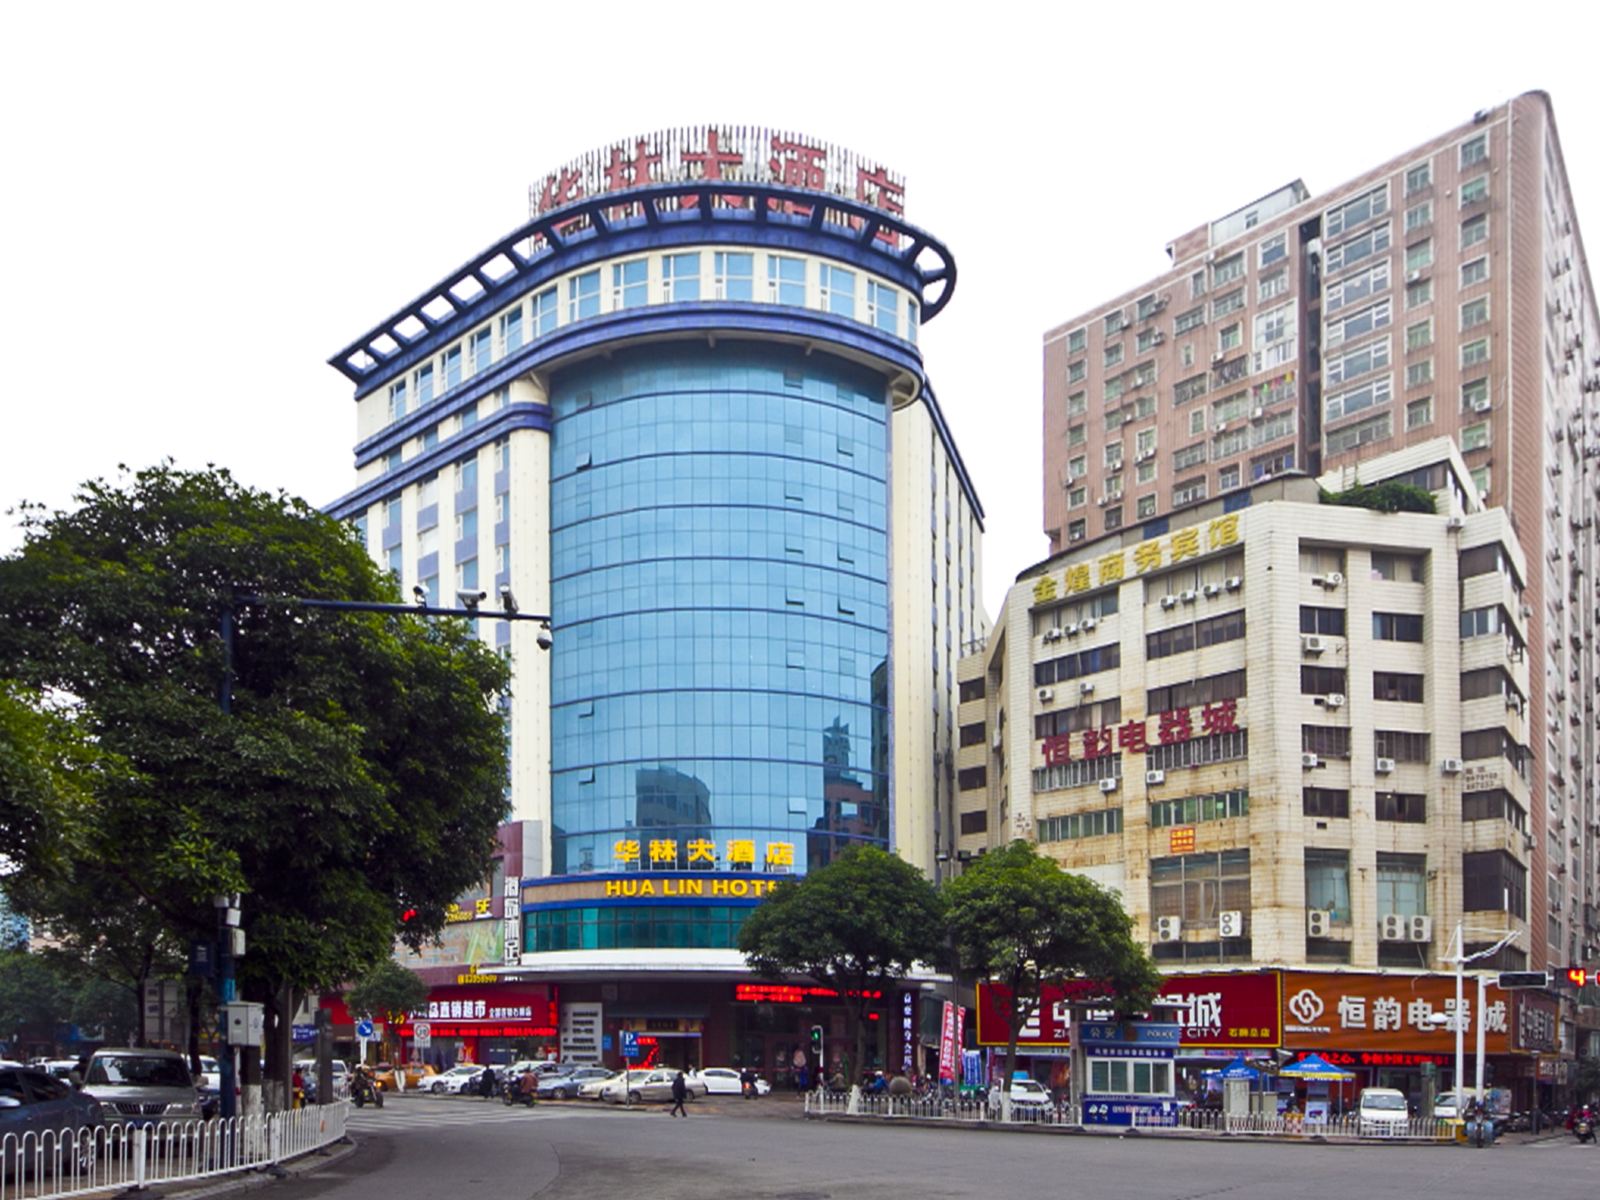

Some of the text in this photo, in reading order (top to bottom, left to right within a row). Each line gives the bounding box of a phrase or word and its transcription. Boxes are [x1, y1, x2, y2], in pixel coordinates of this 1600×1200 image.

[1032, 513, 1240, 604] 金煌商务宾馆
[1041, 698, 1239, 768] 恒韵电器城
[613, 839, 796, 865] 华林大酒店
[605, 879, 655, 896] HUA
[662, 879, 702, 895] LIN
[1569, 970, 1586, 986] 4
[1146, 1030, 1175, 1038] POLICE
[1186, 1028, 1221, 1038] CITY
